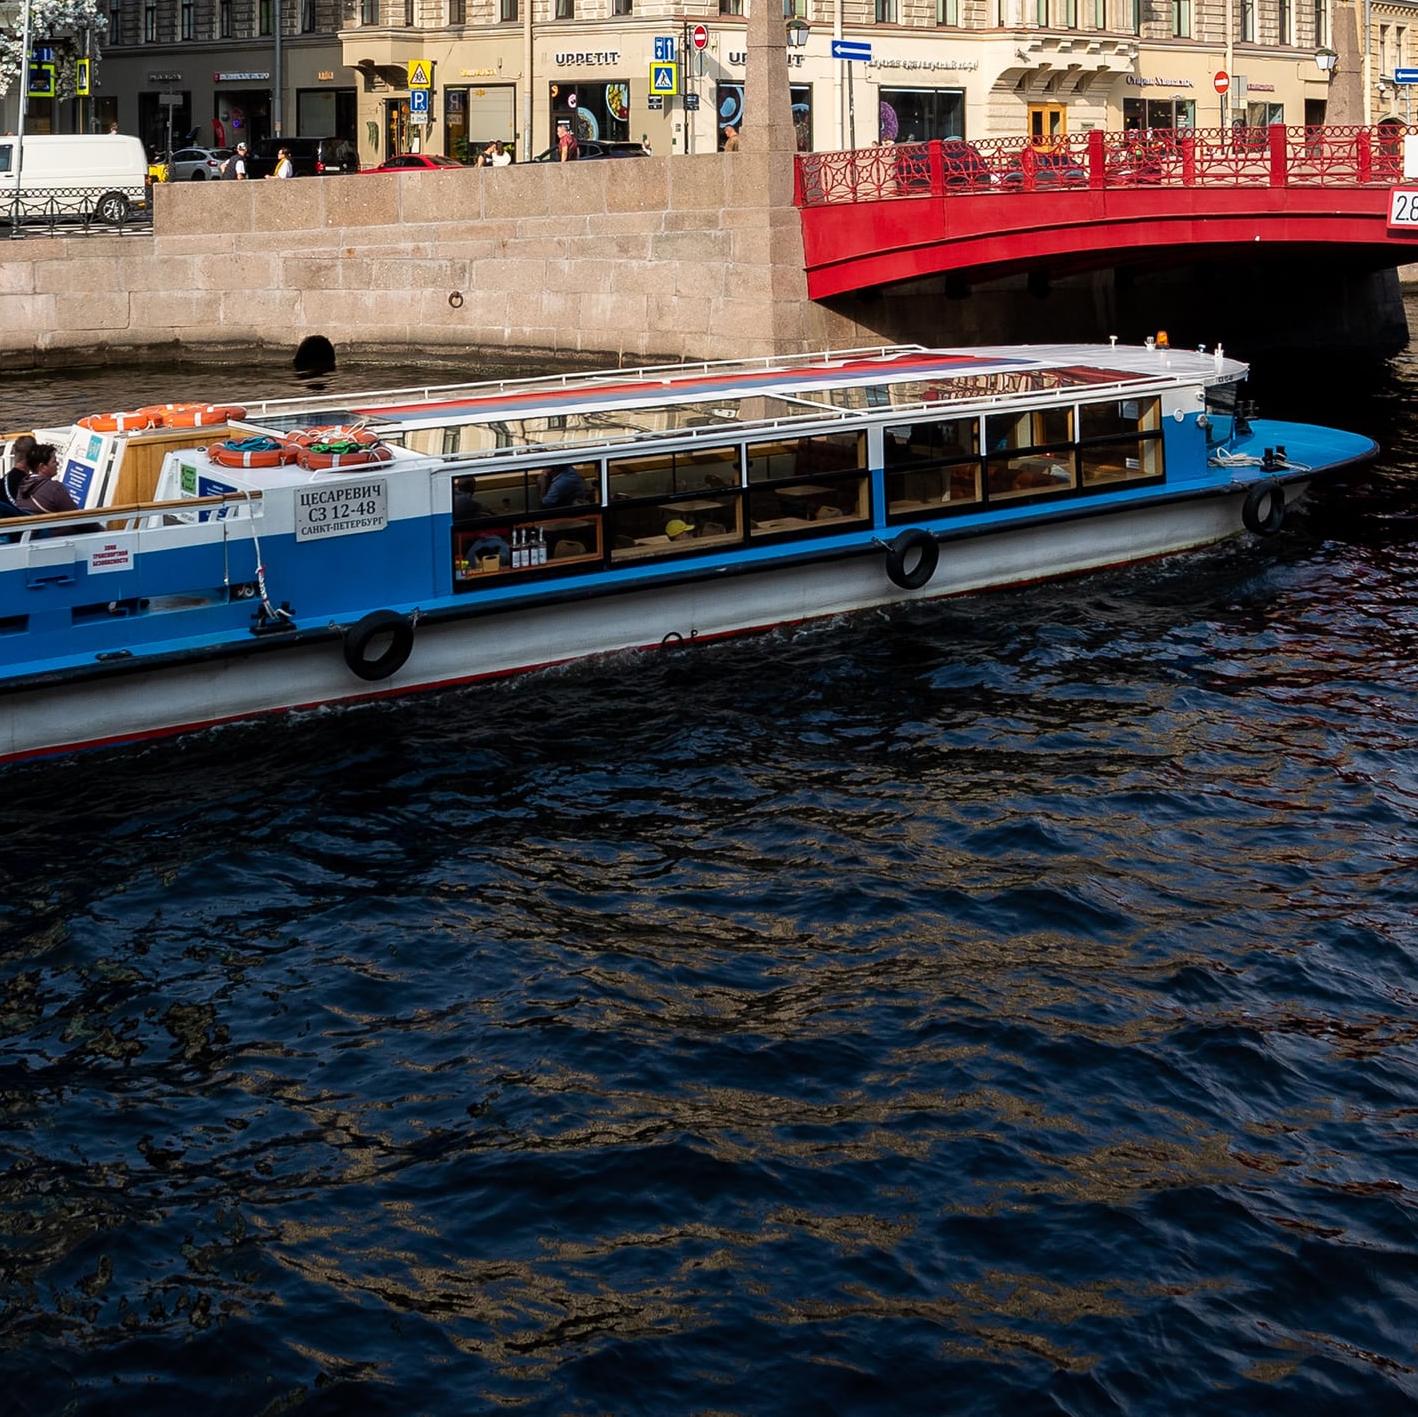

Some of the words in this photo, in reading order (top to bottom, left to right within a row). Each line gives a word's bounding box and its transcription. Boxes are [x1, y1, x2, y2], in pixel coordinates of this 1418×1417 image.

[556, 52, 621, 66] UPPETIT
[300, 484, 382, 507] ЦЕСАРЕВИЧ
[332, 500, 376, 520] 12-48
[301, 516, 384, 535] САНКТ-ПЕТЕРБУРГ
